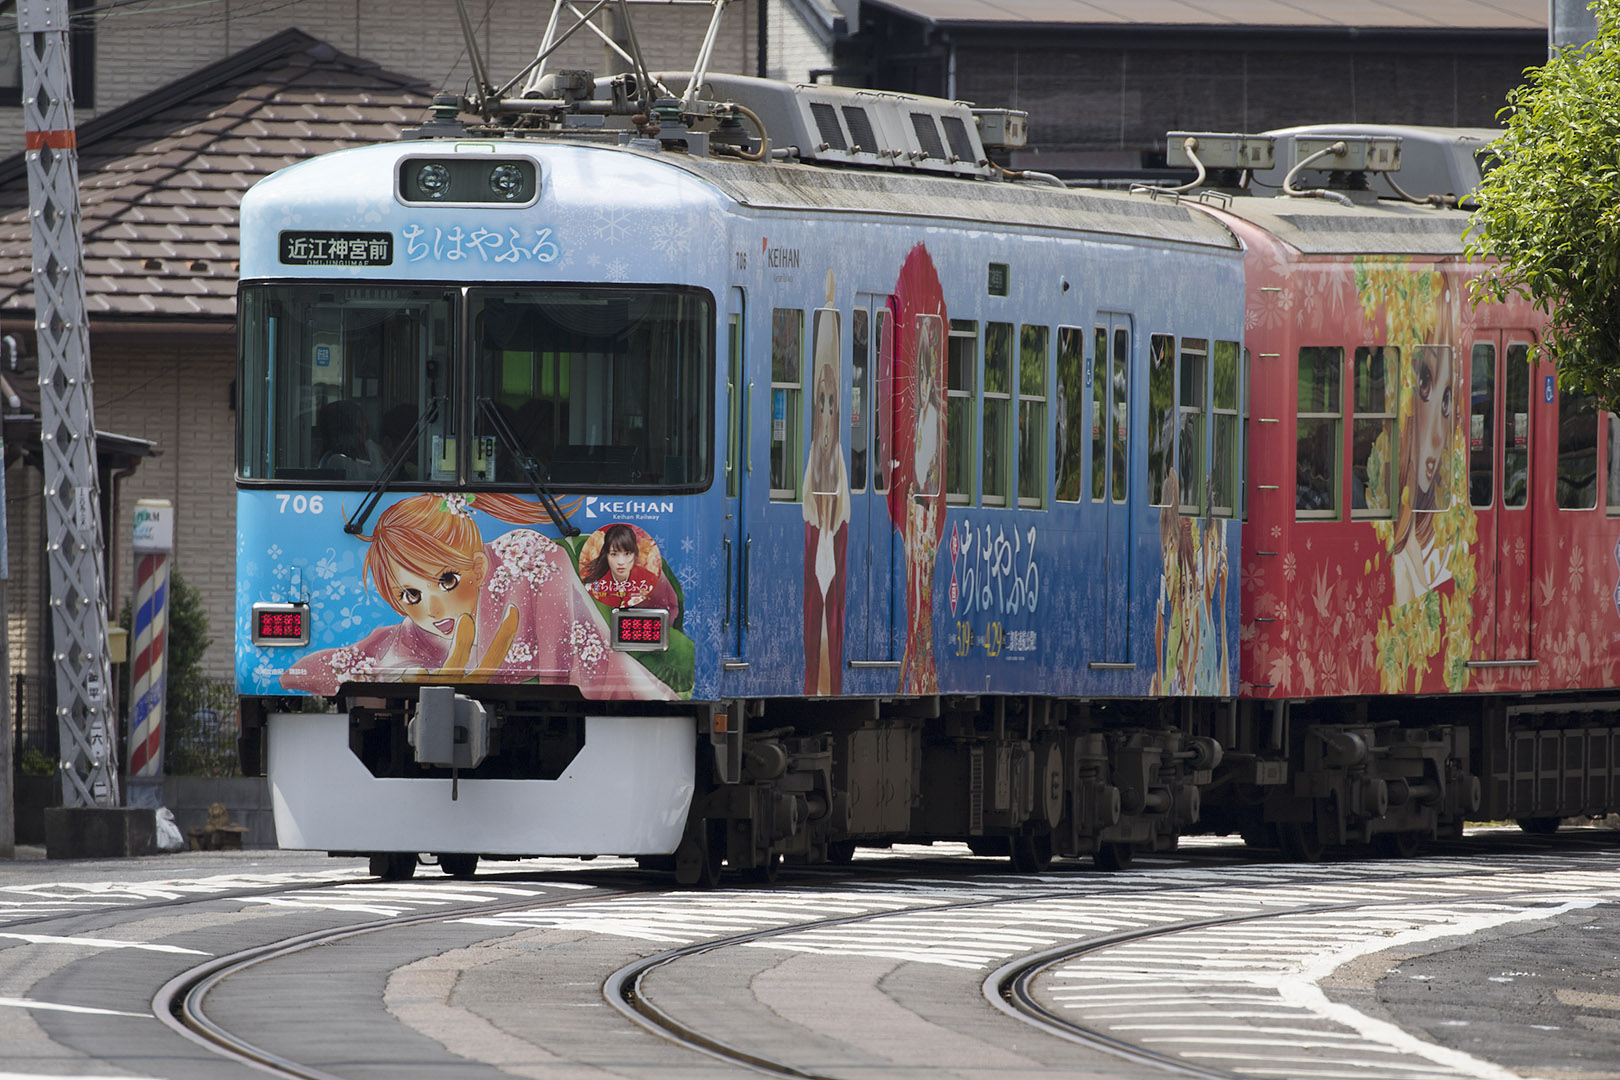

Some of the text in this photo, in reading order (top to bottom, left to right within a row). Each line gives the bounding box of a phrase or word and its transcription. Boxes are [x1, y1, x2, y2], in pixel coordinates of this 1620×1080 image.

[287, 237, 389, 260] 近江神宮前
[402, 224, 559, 263] ちはやふる
[768, 247, 800, 268] KEIHAN
[275, 494, 324, 514] 706
[600, 500, 674, 513] KEIHAN
[960, 519, 1039, 615] ちはやふる
[600, 579, 649, 592] ちはやふる
